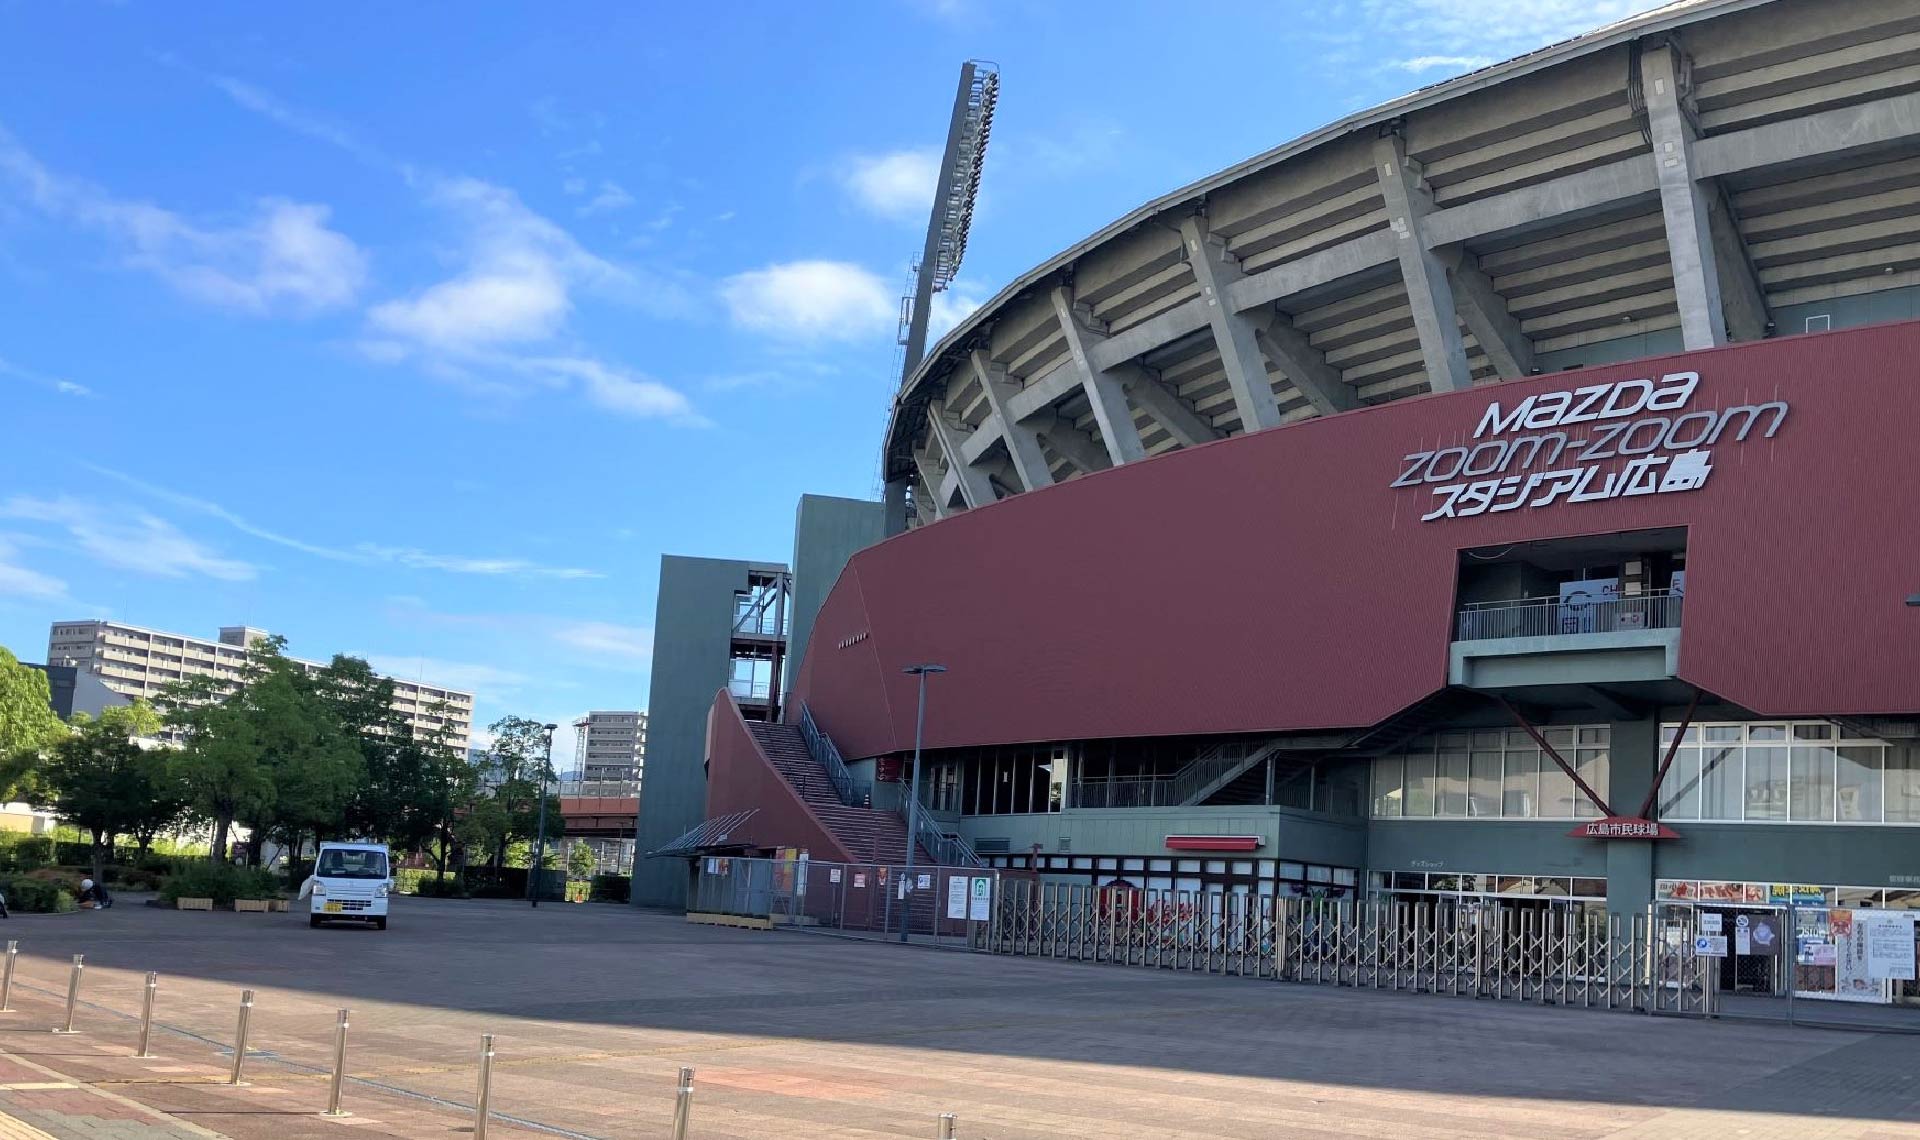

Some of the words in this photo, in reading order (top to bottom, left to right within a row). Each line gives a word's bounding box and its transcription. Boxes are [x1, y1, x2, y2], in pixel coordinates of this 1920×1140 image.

[1421, 449, 1712, 521] スタジアム広島
[1586, 823, 1659, 836] 広島市民球場
